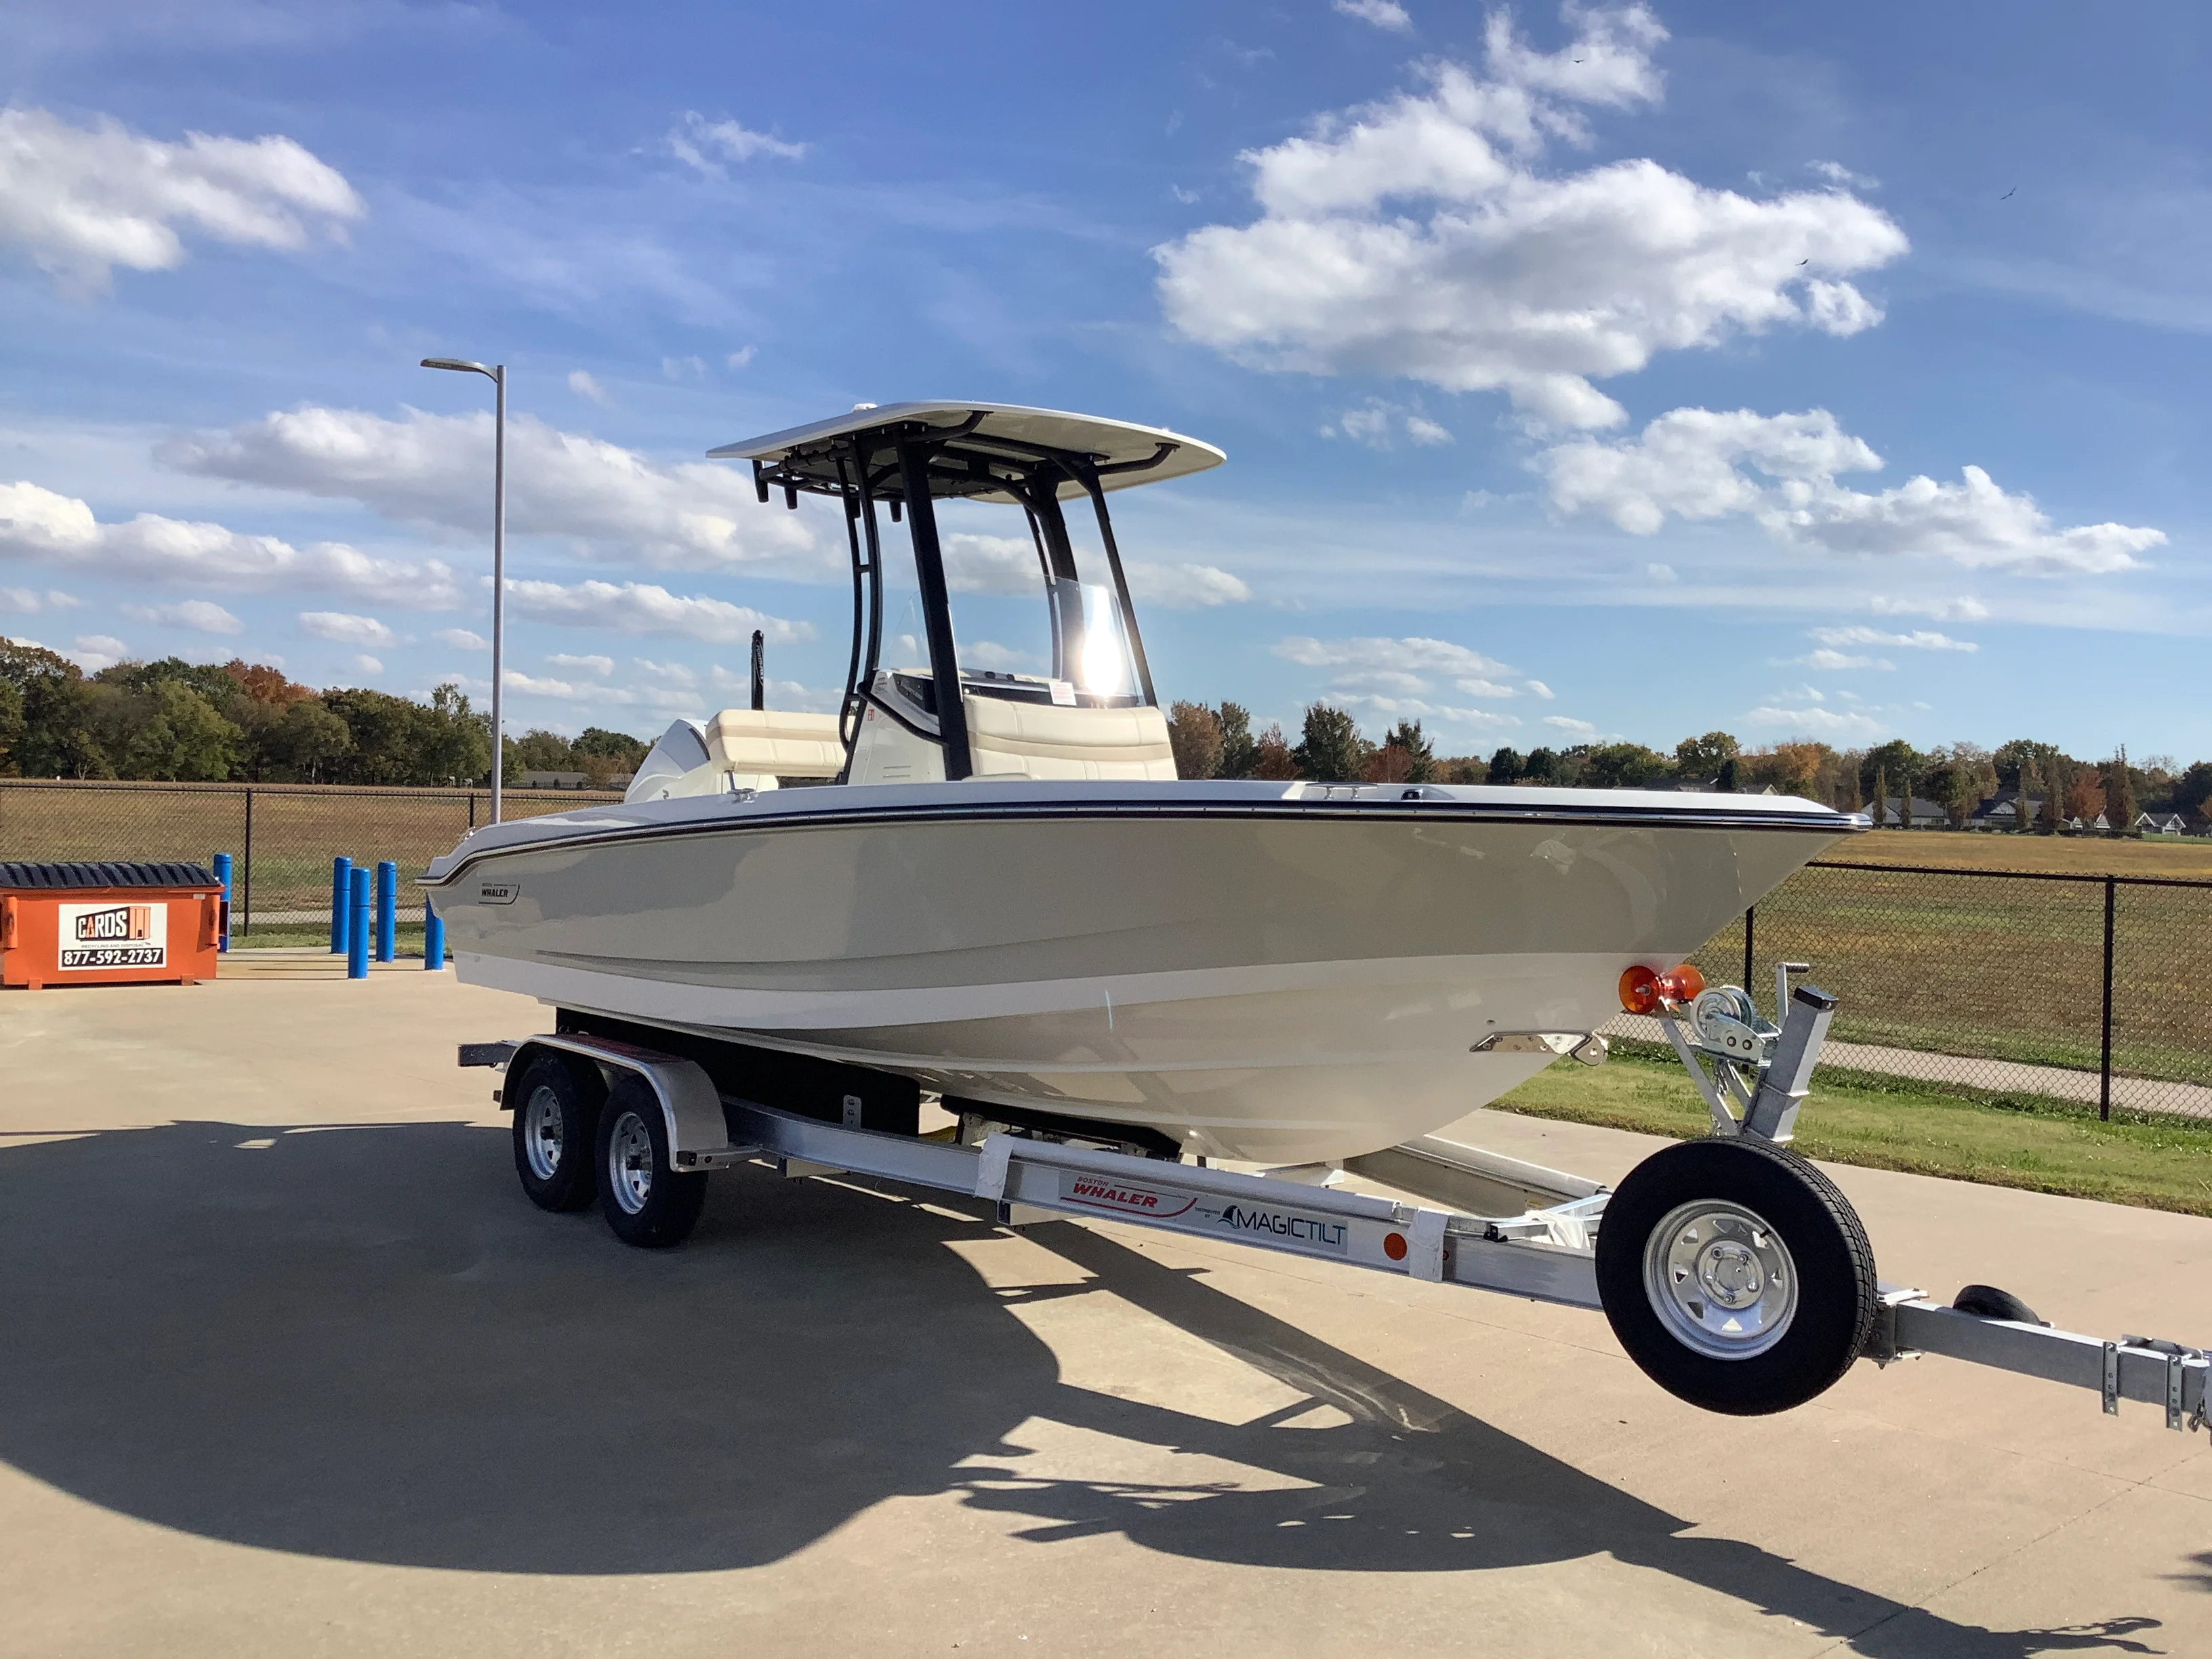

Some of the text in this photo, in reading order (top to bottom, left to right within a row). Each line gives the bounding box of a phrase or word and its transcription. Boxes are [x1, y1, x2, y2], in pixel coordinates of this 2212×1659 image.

[481, 888, 508, 897] WHALER
[78, 910, 127, 939] CARDS
[64, 949, 162, 966] 877-592-2737
[1076, 1176, 1109, 1187] BOSTON
[1073, 1183, 1158, 1208] WHALER
[1237, 1208, 1347, 1246] MAGICTILT
